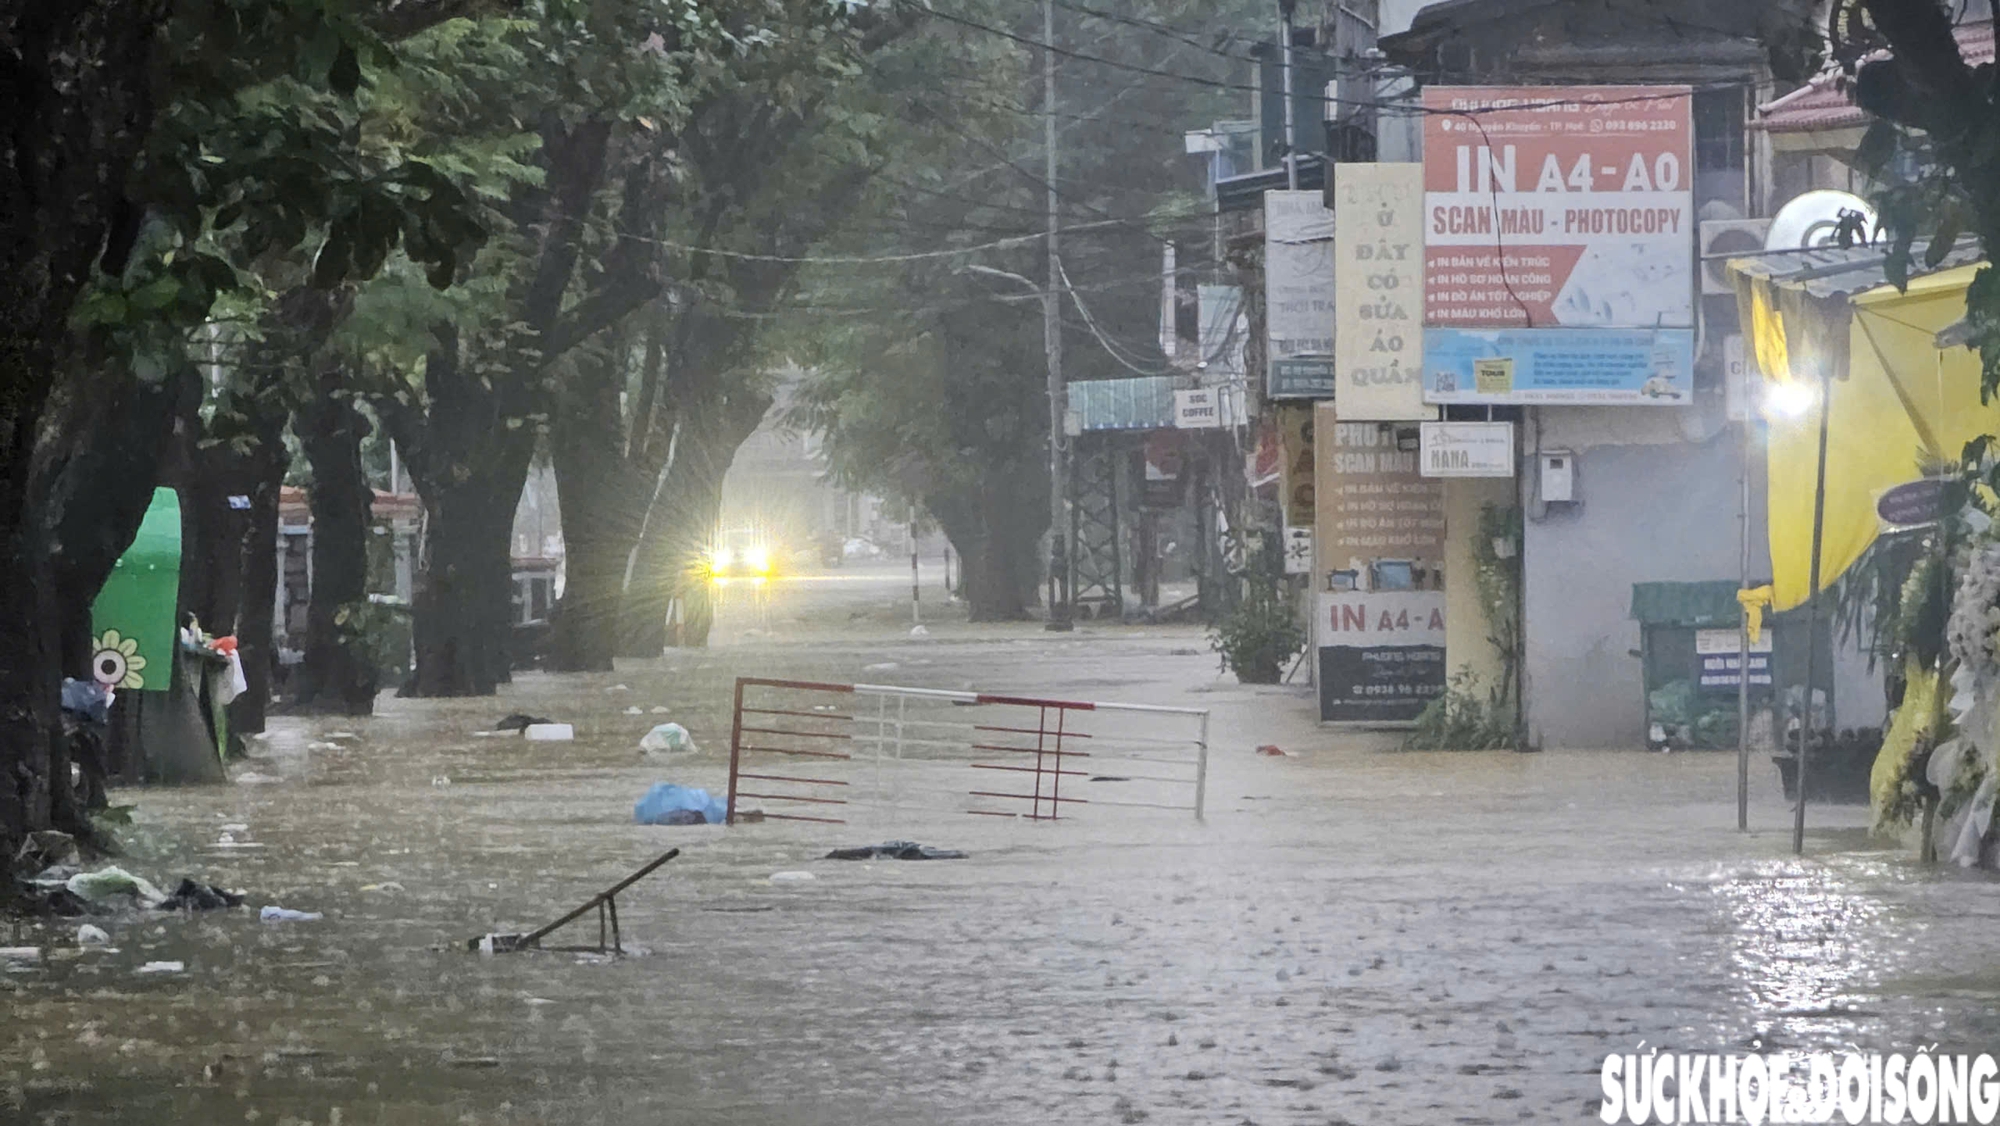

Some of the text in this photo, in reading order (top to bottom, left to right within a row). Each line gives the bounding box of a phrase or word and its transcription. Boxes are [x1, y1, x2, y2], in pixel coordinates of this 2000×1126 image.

[1457, 146, 1516, 193] IN
[1433, 206, 1491, 235] SCAN
[1501, 205, 1544, 235] MÀU
[1565, 209, 1680, 234] PHOTOCOPY
[1437, 257, 1449, 267] IN
[1437, 275, 1449, 284] IN
[1437, 291, 1449, 301] IN
[1437, 309, 1449, 318] IN
[1330, 604, 1366, 632] IN
